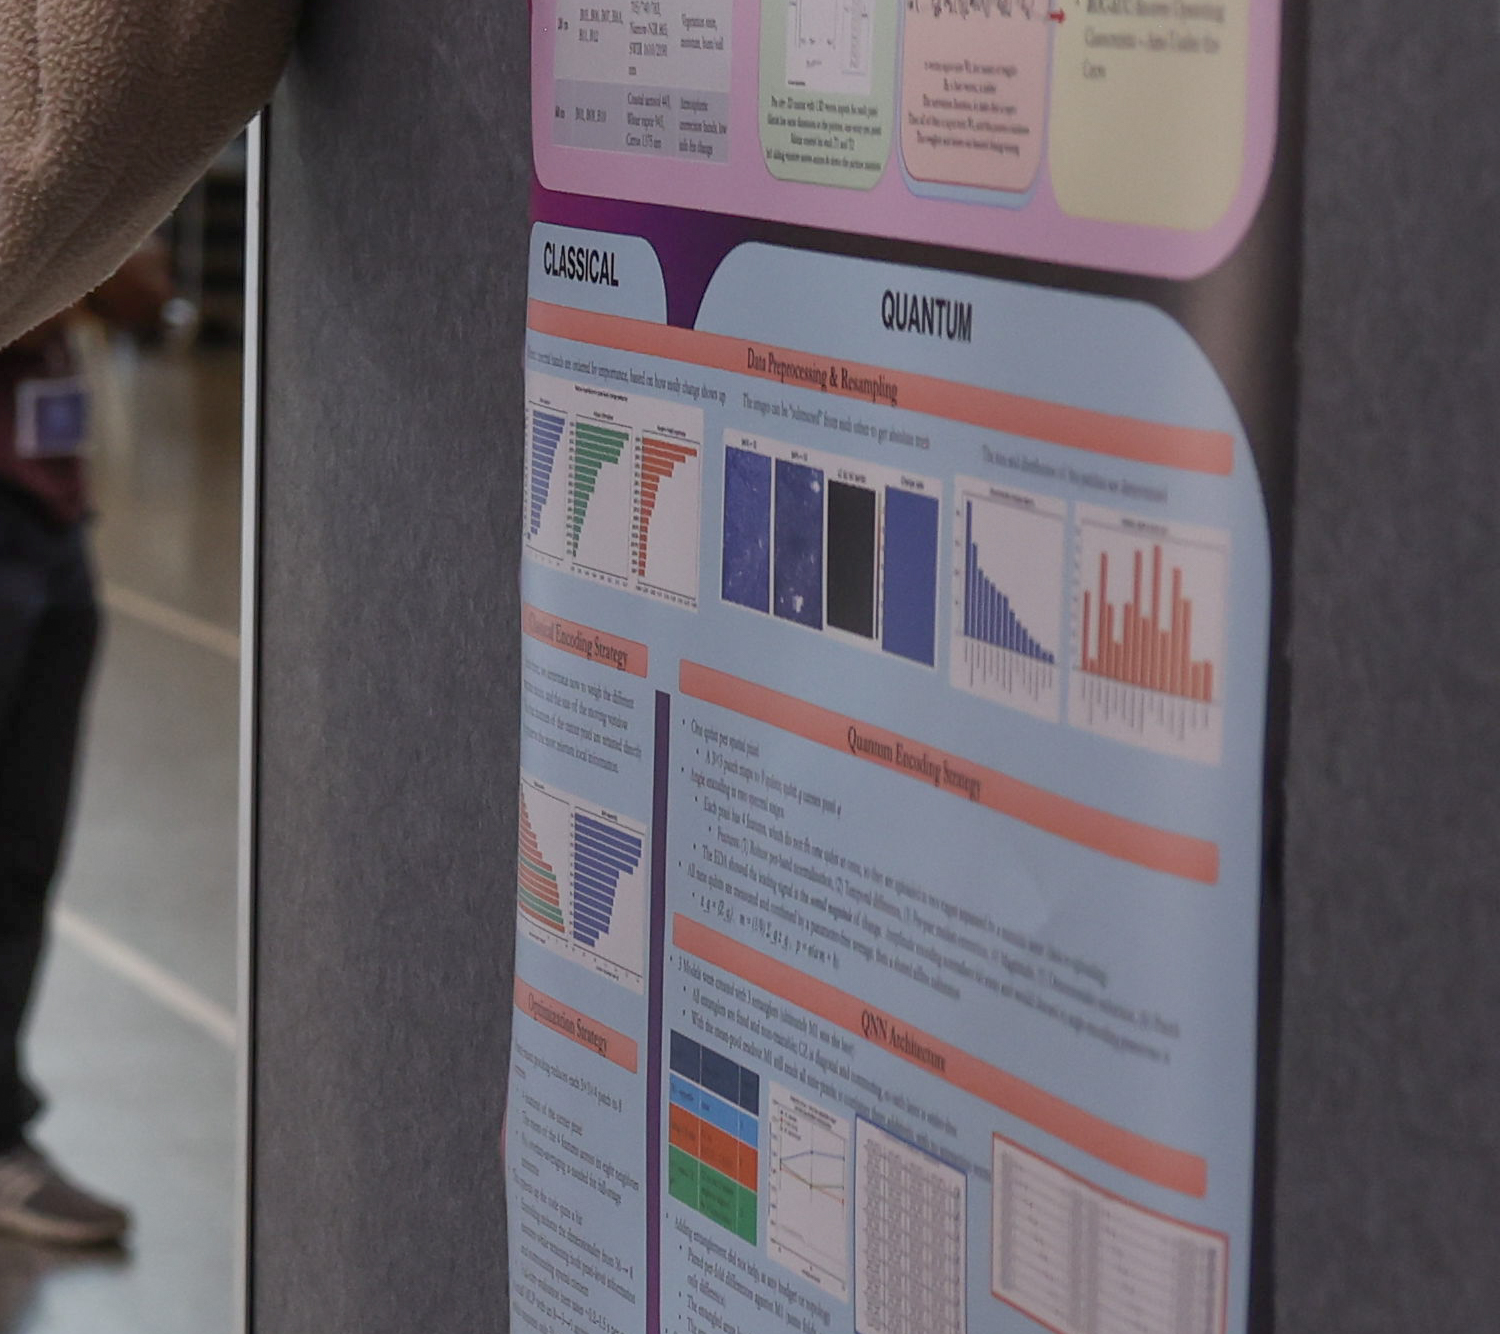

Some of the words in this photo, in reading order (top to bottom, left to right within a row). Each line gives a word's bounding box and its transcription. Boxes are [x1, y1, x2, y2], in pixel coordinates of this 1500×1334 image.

[543, 240, 619, 288] CLASSICAL
[881, 289, 973, 343] QUANTUM
[747, 348, 766, 370] Data
[767, 355, 827, 389] Preprocessing
[829, 368, 838, 387] &
[841, 370, 897, 404] Resampling
[556, 623, 592, 659] Encoding
[594, 634, 627, 672] Strategy
[847, 724, 893, 767] Quantum
[894, 739, 940, 788] Encoding
[941, 757, 983, 804] Strategy
[528, 992, 574, 1039] Optimization
[576, 1017, 607, 1059] Strategy
[861, 1010, 887, 1041] QNN
[890, 1025, 946, 1069] Architecture
